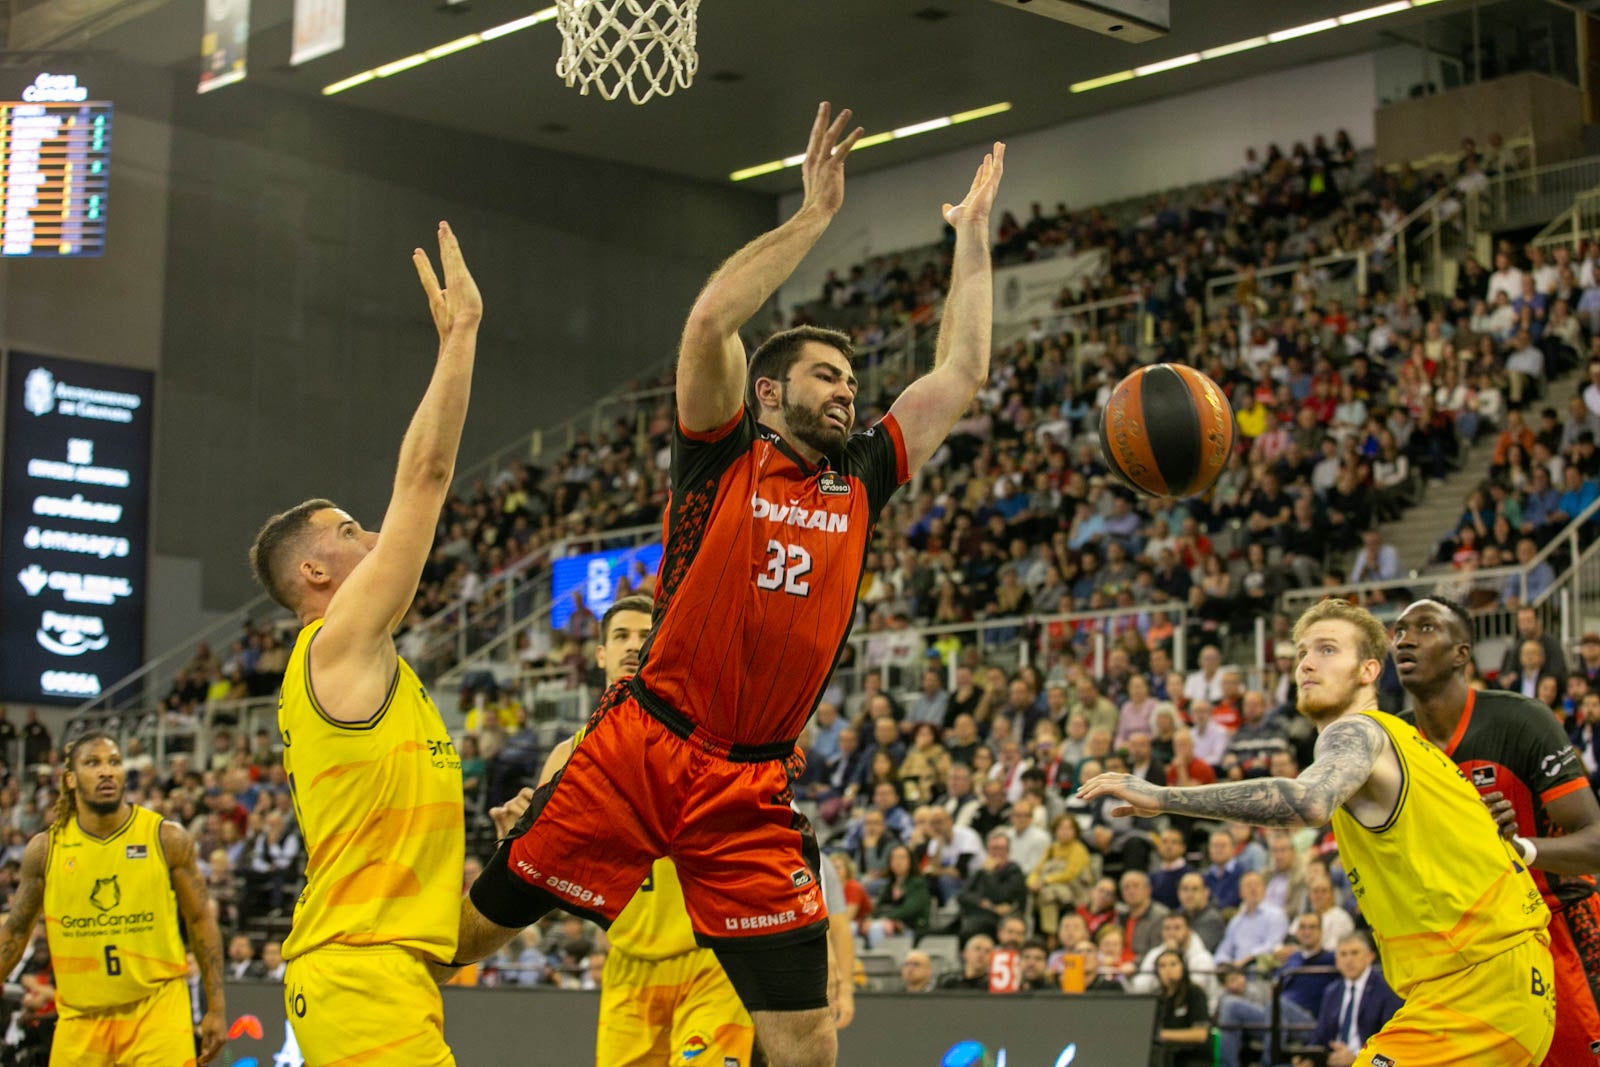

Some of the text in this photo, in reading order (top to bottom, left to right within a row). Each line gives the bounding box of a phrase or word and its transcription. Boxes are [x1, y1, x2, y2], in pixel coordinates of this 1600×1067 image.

[757, 539, 812, 597] 32
[740, 909, 797, 930] BERNER
[104, 944, 121, 977] 6
